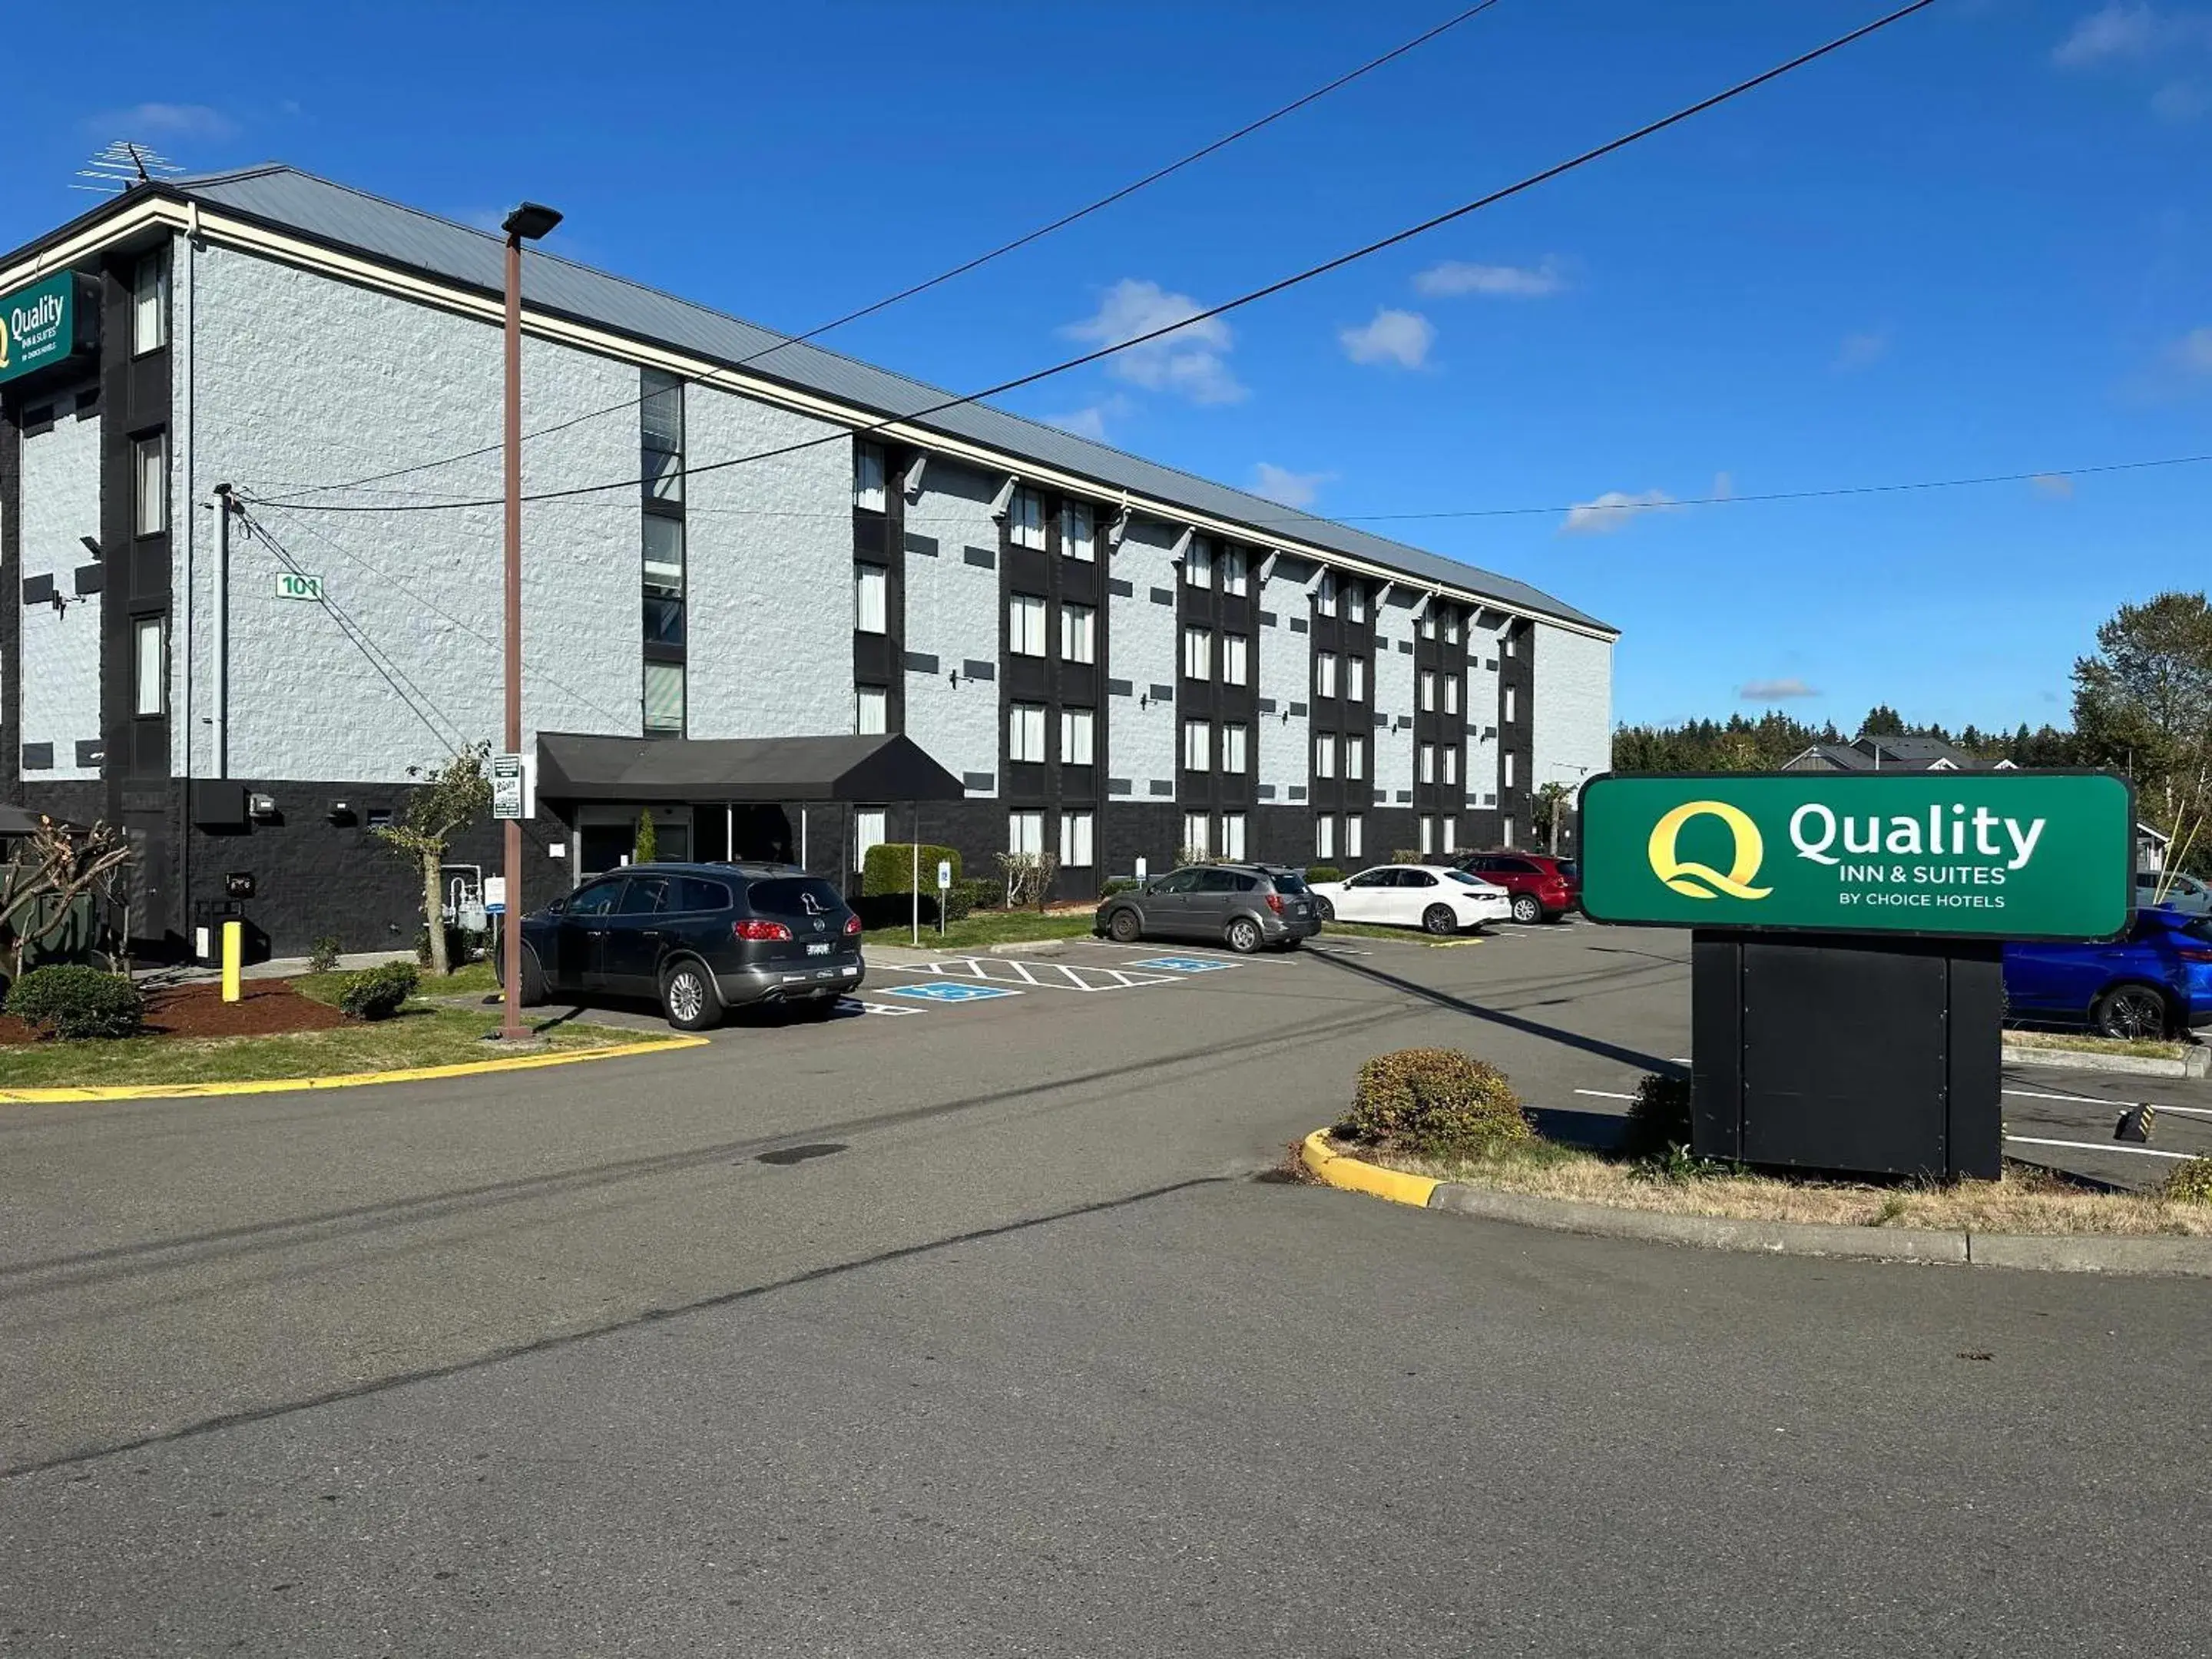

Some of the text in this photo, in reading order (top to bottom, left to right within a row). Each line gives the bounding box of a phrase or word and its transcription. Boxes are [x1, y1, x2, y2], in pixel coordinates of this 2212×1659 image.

[12, 294, 64, 342] Quality
[283, 576, 316, 596] 101
[1647, 800, 1773, 899] Q
[1789, 803, 2045, 870] Quality
[1839, 865, 2006, 886] INN & SUITES
[1839, 892, 2005, 909] BY CHOICE HOTELS
